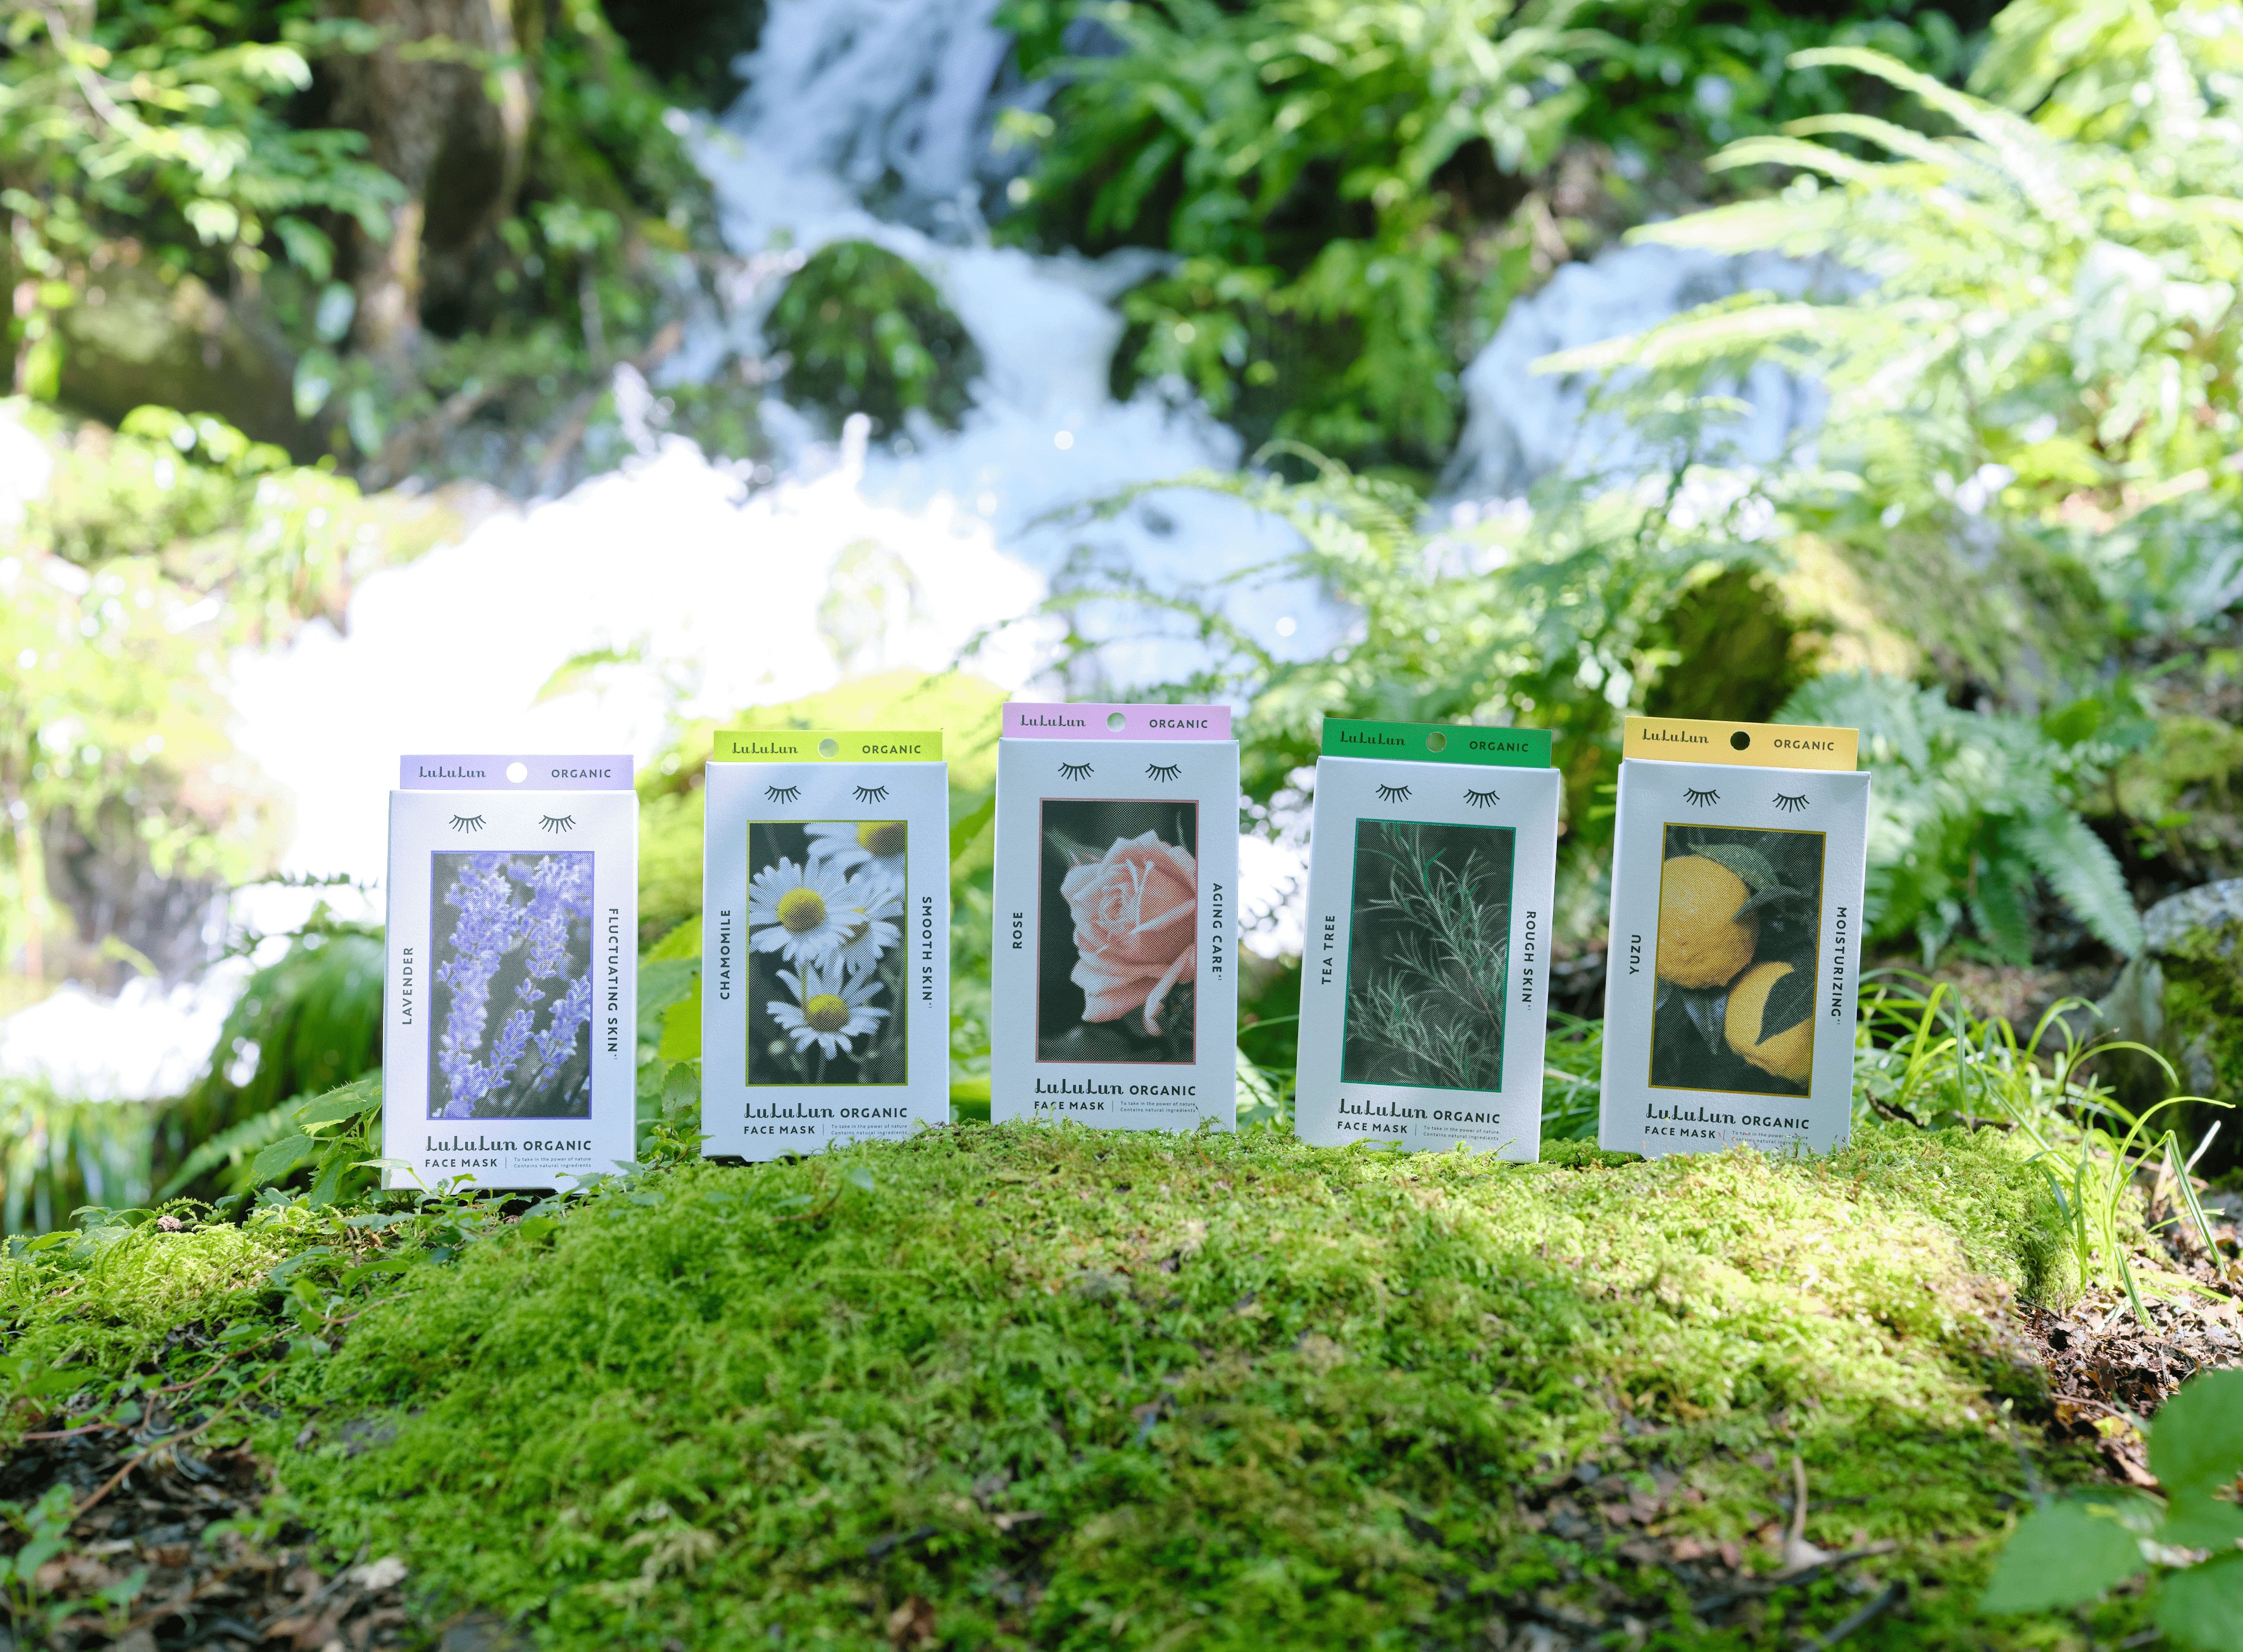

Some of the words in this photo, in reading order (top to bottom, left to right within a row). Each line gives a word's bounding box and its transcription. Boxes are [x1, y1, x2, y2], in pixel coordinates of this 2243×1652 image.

[1020, 715, 1086, 727] LuLuLun
[1149, 719, 1208, 729] ORGANIC
[732, 742, 799, 754] LuLuLun
[862, 745, 921, 754] ORGANIC
[1339, 730, 1406, 746] LuLuLun
[1469, 741, 1529, 753] ORGANIC
[1642, 728, 1709, 744] LuLuLun
[1773, 739, 1834, 751] ORGANIC
[418, 766, 486, 778] LuLuLun
[551, 769, 611, 778] ORGANIC
[1213, 882, 1223, 929] AGING
[922, 896, 932, 960] SMOOTH
[1012, 912, 1023, 949] ROSE
[1323, 915, 1335, 951] TREE
[1524, 911, 1537, 962] ROUGH
[608, 908, 618, 1011] FLUCTUATING
[720, 910, 730, 1000] CHAMOMILE
[1629, 934, 1641, 975] YUZU
[1321, 957, 1333, 985] TEA
[402, 947, 413, 1025] LAVENDER
[1034, 1078, 1124, 1095] LuLuLun
[1129, 1085, 1196, 1096] ORGANIC
[744, 1103, 835, 1118] LuLuLun
[840, 1108, 908, 1118] ORGANIC
[1069, 1101, 1104, 1110] MASK
[1338, 1098, 1428, 1119] LuLuLun
[1433, 1110, 1500, 1124] ORGANIC
[1646, 1103, 1736, 1124] LuLuLun
[1742, 1115, 1809, 1129] ORGANIC
[744, 1126, 775, 1134] FACE
[779, 1125, 815, 1134] MASK
[1337, 1121, 1368, 1131] FACE
[1372, 1123, 1408, 1134] MASK
[1645, 1125, 1675, 1136] FACE
[1680, 1128, 1716, 1139] MASK
[425, 1136, 518, 1151] LuLuLun
[523, 1140, 591, 1151] ORGANIC
[425, 1159, 456, 1167] FACE
[461, 1158, 497, 1167] MASK
